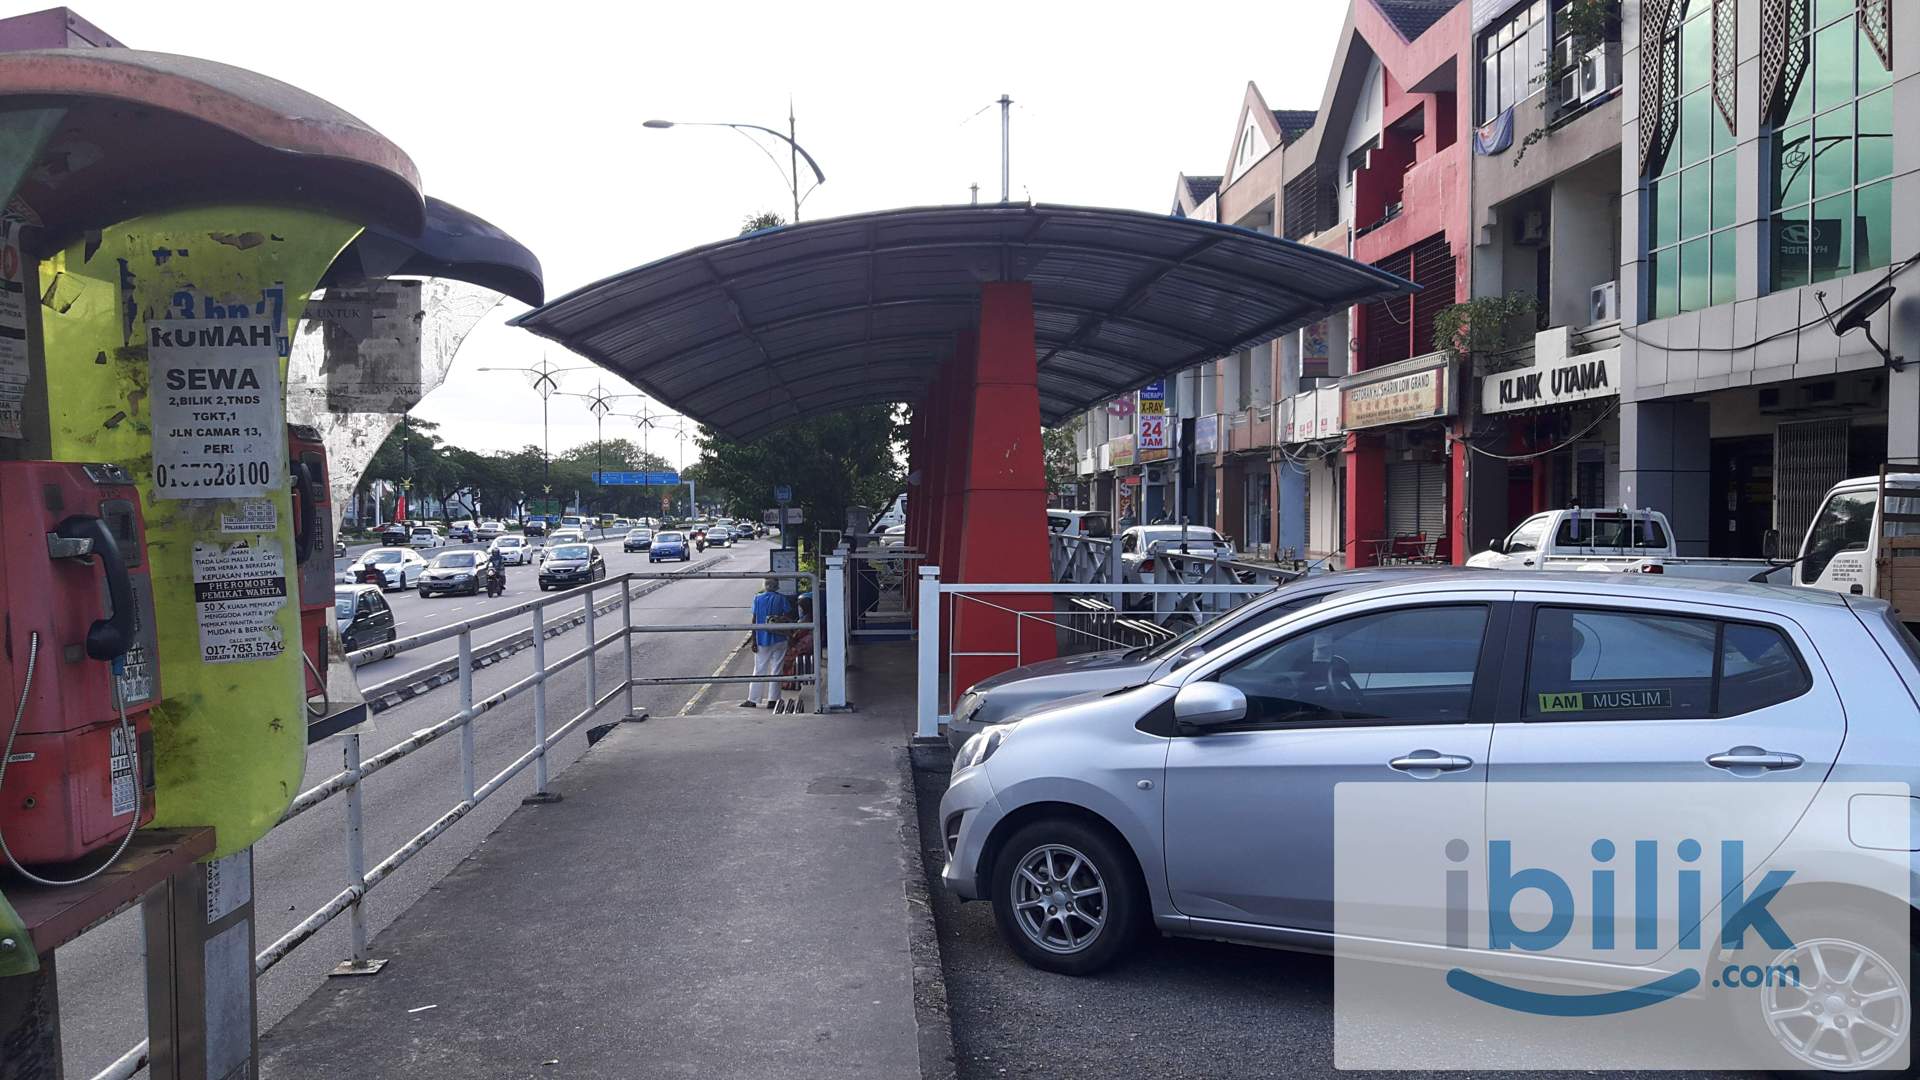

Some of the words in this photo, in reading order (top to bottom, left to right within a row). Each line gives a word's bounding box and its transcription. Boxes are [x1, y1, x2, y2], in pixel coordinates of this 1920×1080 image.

[166, 368, 260, 390] SEWA
[1411, 374, 1430, 390] GRAND
[1500, 371, 1542, 404] KLINIK
[1551, 360, 1608, 396] UTAMA
[169, 396, 212, 407] 2,BILIK
[216, 395, 260, 406] 2,TNDS
[1141, 391, 1164, 399] THERAPY
[1141, 402, 1164, 413] X-RAY
[193, 412, 236, 422] TGKT,1
[169, 428, 192, 437] JLN
[196, 428, 240, 437] CAMAR
[1142, 421, 1162, 437] 24
[1141, 438, 1163, 447] JAM
[202, 573, 241, 581] KEPUASAN
[243, 570, 277, 578] MAKSIMA
[209, 578, 274, 590] PHEROMONE
[202, 589, 243, 600] PEMIKAT
[246, 587, 281, 597] WANITA
[204, 602, 215, 611] 50
[207, 628, 236, 636] MUDAH
[1542, 695, 1548, 709] I
[1552, 694, 1578, 709] AM
[1593, 692, 1661, 708] MUSLIM
